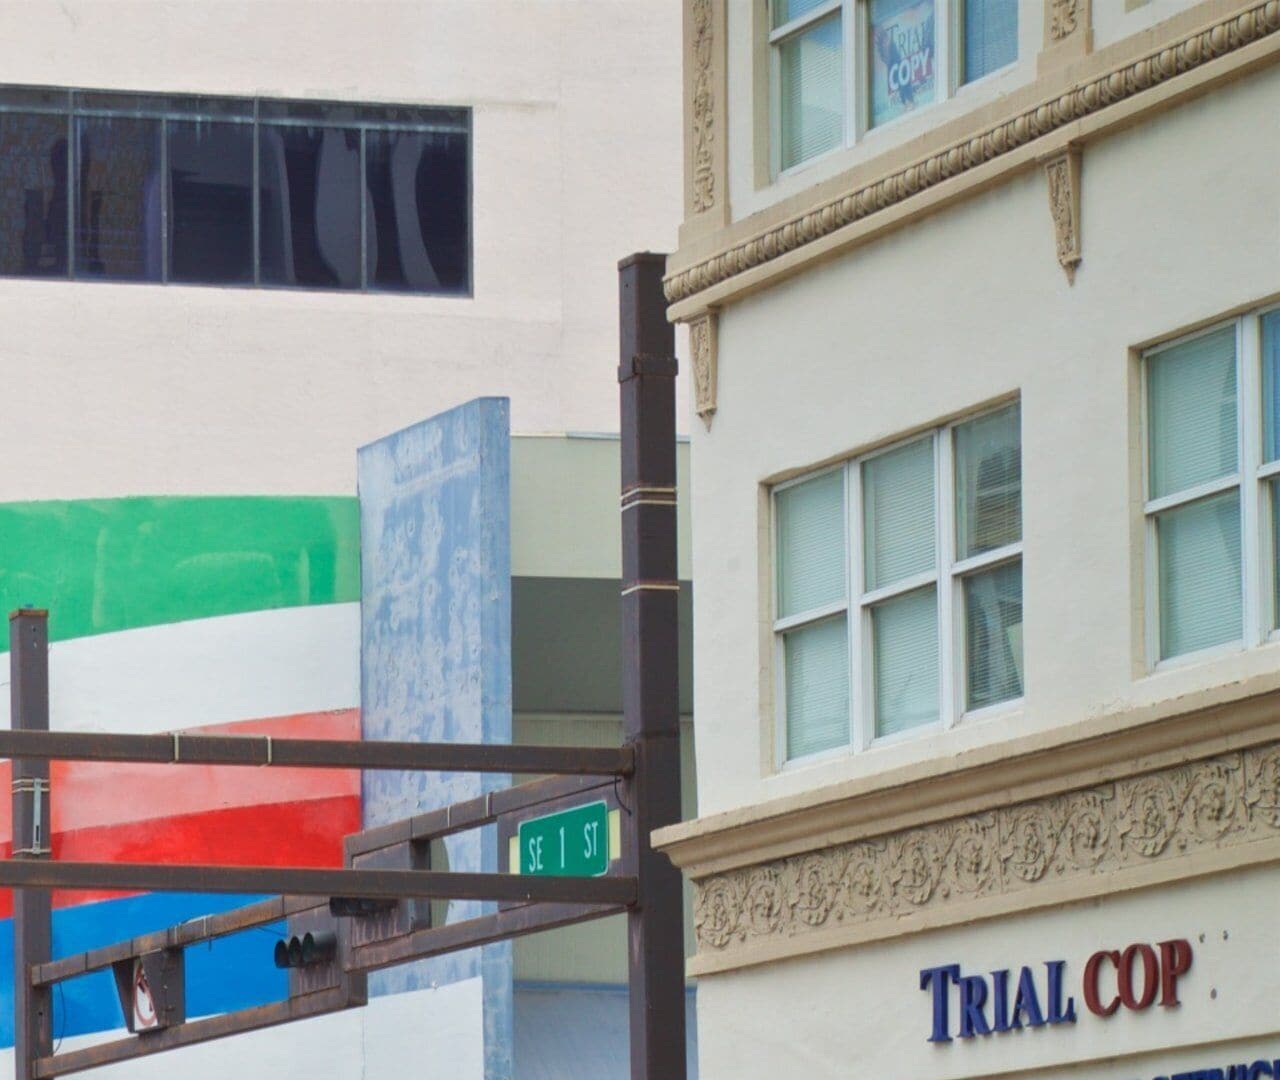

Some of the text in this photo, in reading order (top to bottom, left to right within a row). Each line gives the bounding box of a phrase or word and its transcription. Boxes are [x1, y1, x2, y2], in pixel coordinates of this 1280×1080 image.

[889, 48, 929, 90] COPY
[528, 821, 598, 873] SE 1 ST
[920, 938, 1192, 1042] TRIAL COP
